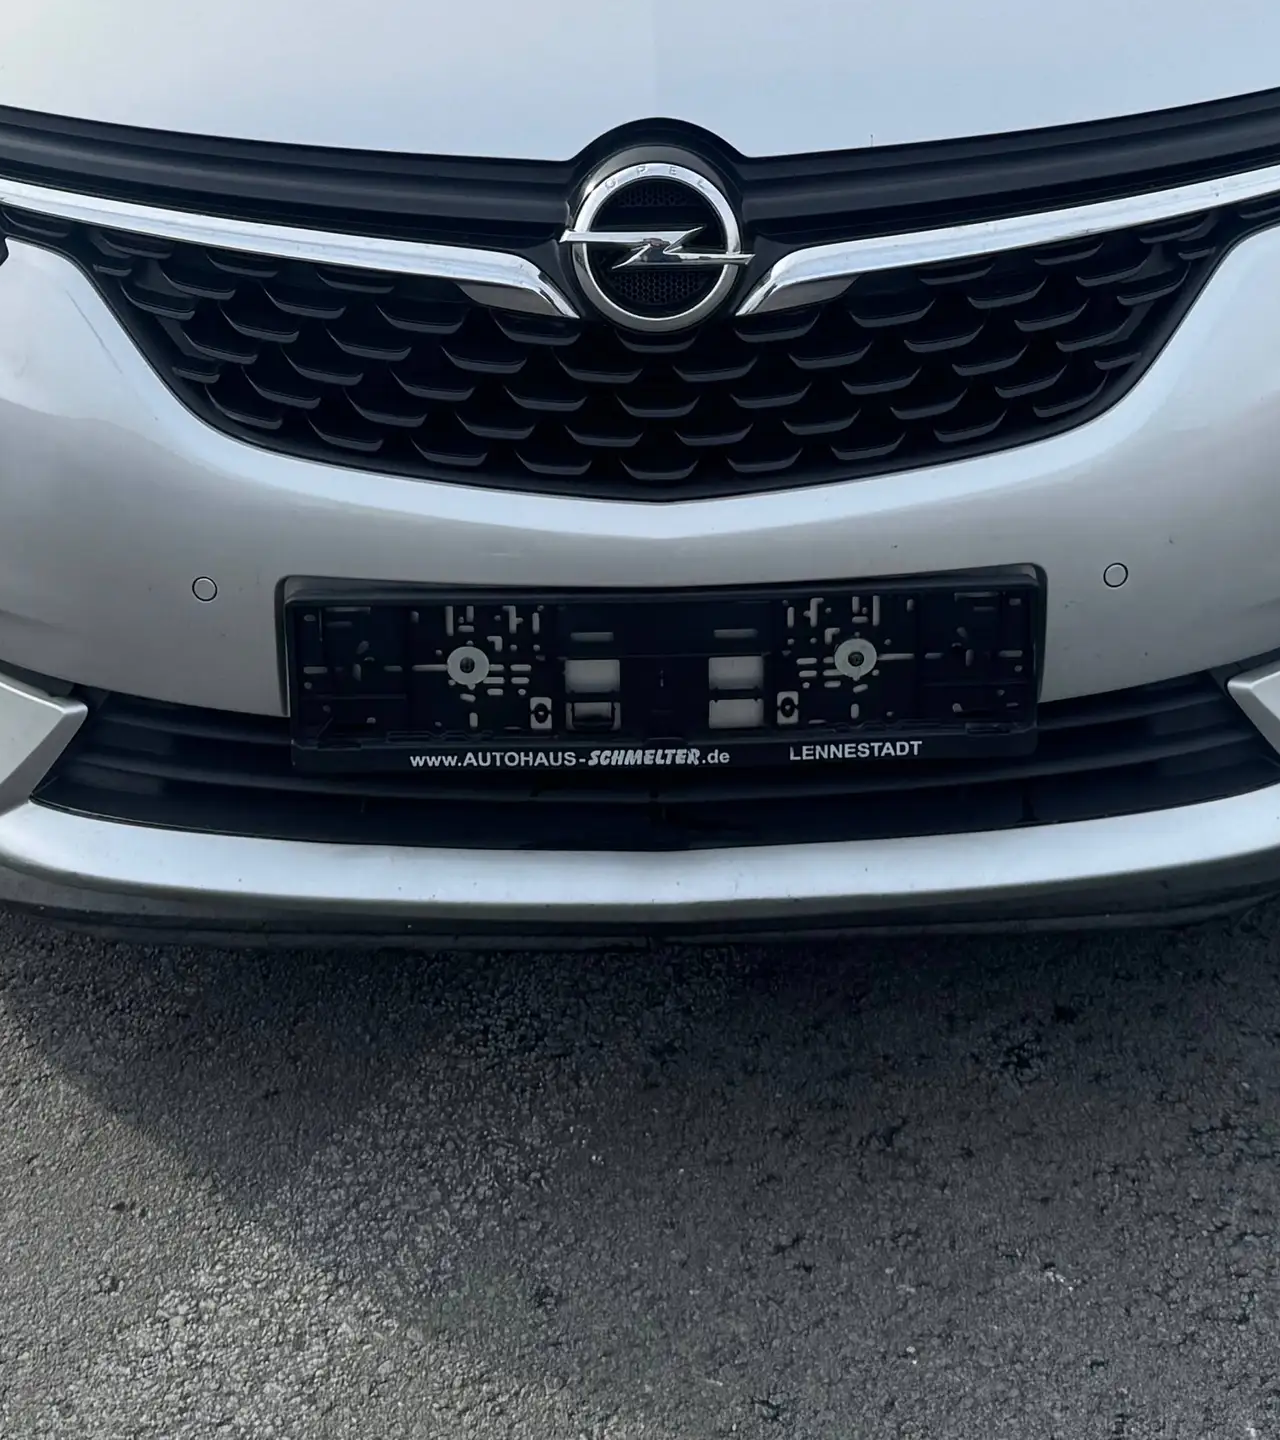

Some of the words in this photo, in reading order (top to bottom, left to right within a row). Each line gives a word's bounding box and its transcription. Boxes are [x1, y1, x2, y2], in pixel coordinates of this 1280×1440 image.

[604, 165, 707, 191] OPEL
[409, 747, 731, 768] www.AUTOHAUS-SCHMELTER.de
[789, 740, 923, 761] LENNESTADT
